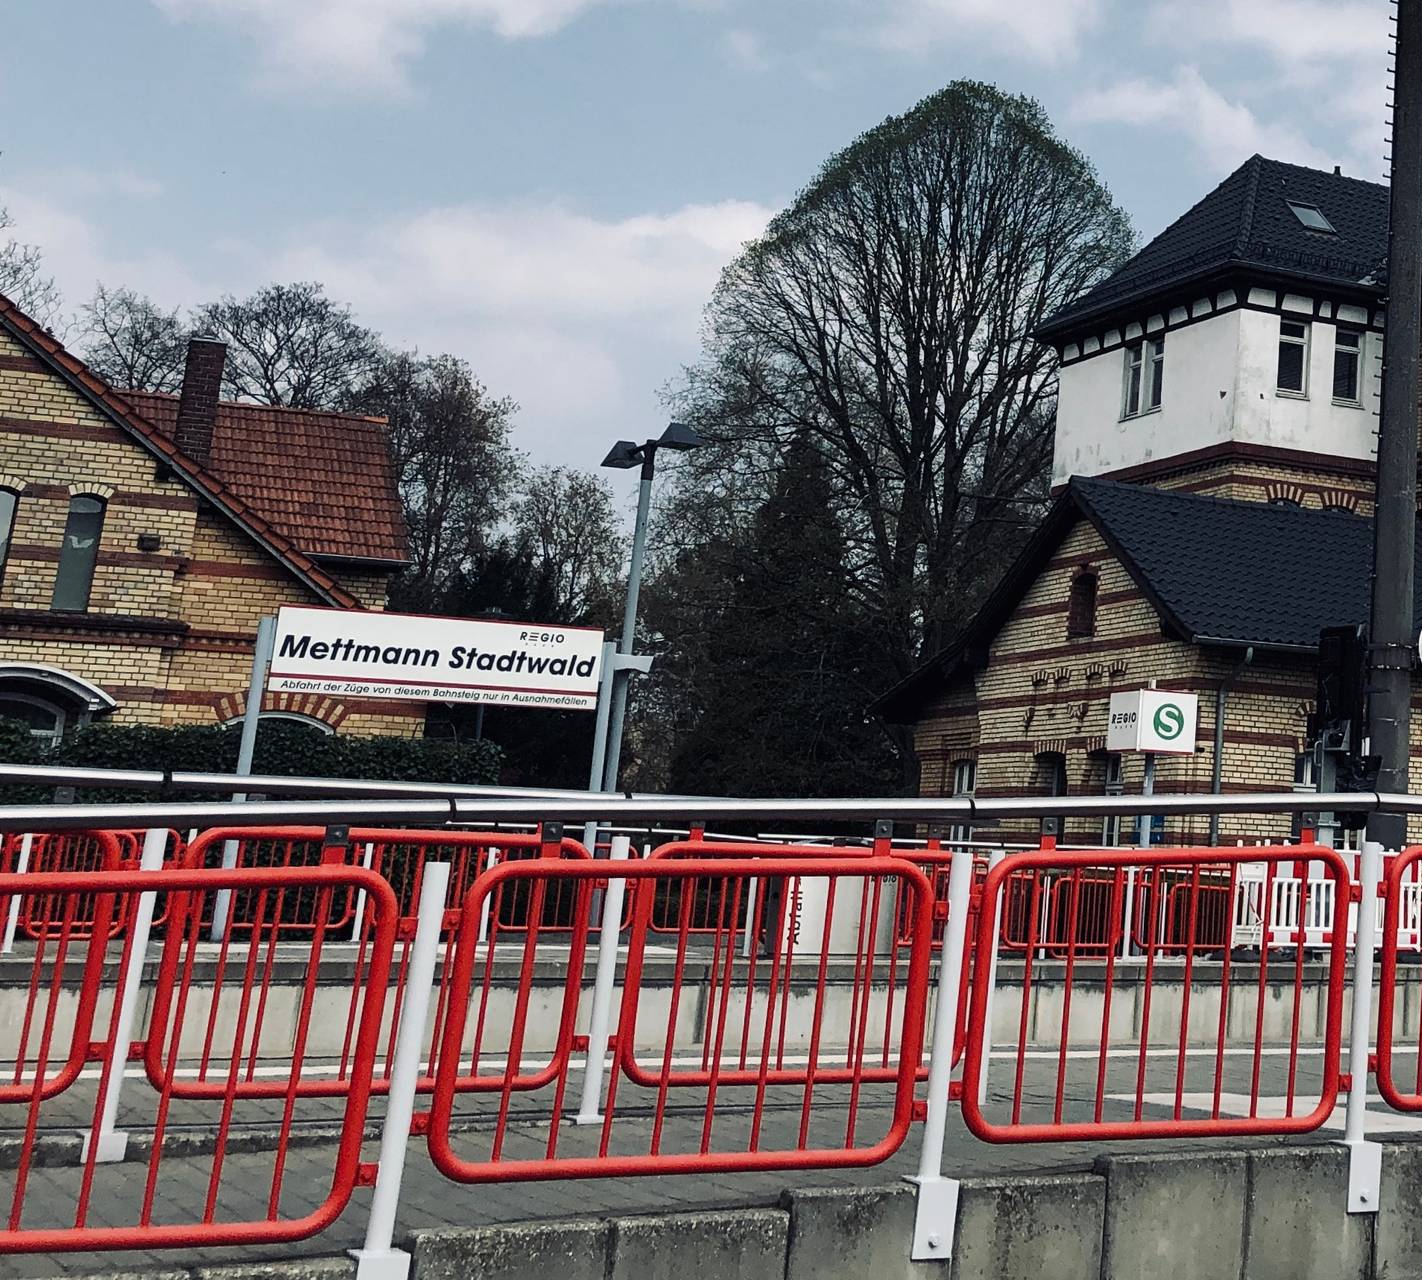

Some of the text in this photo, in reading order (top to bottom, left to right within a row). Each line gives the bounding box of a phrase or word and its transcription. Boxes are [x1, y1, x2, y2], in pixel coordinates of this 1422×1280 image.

[519, 631, 565, 643] REGIO
[279, 634, 596, 678] Mettmann Stadtwald
[280, 680, 588, 706] Abfahrt der Züge von diesem Bahnsteig nur in Ausnahmefällen
[1111, 712, 1137, 724] REGIO
